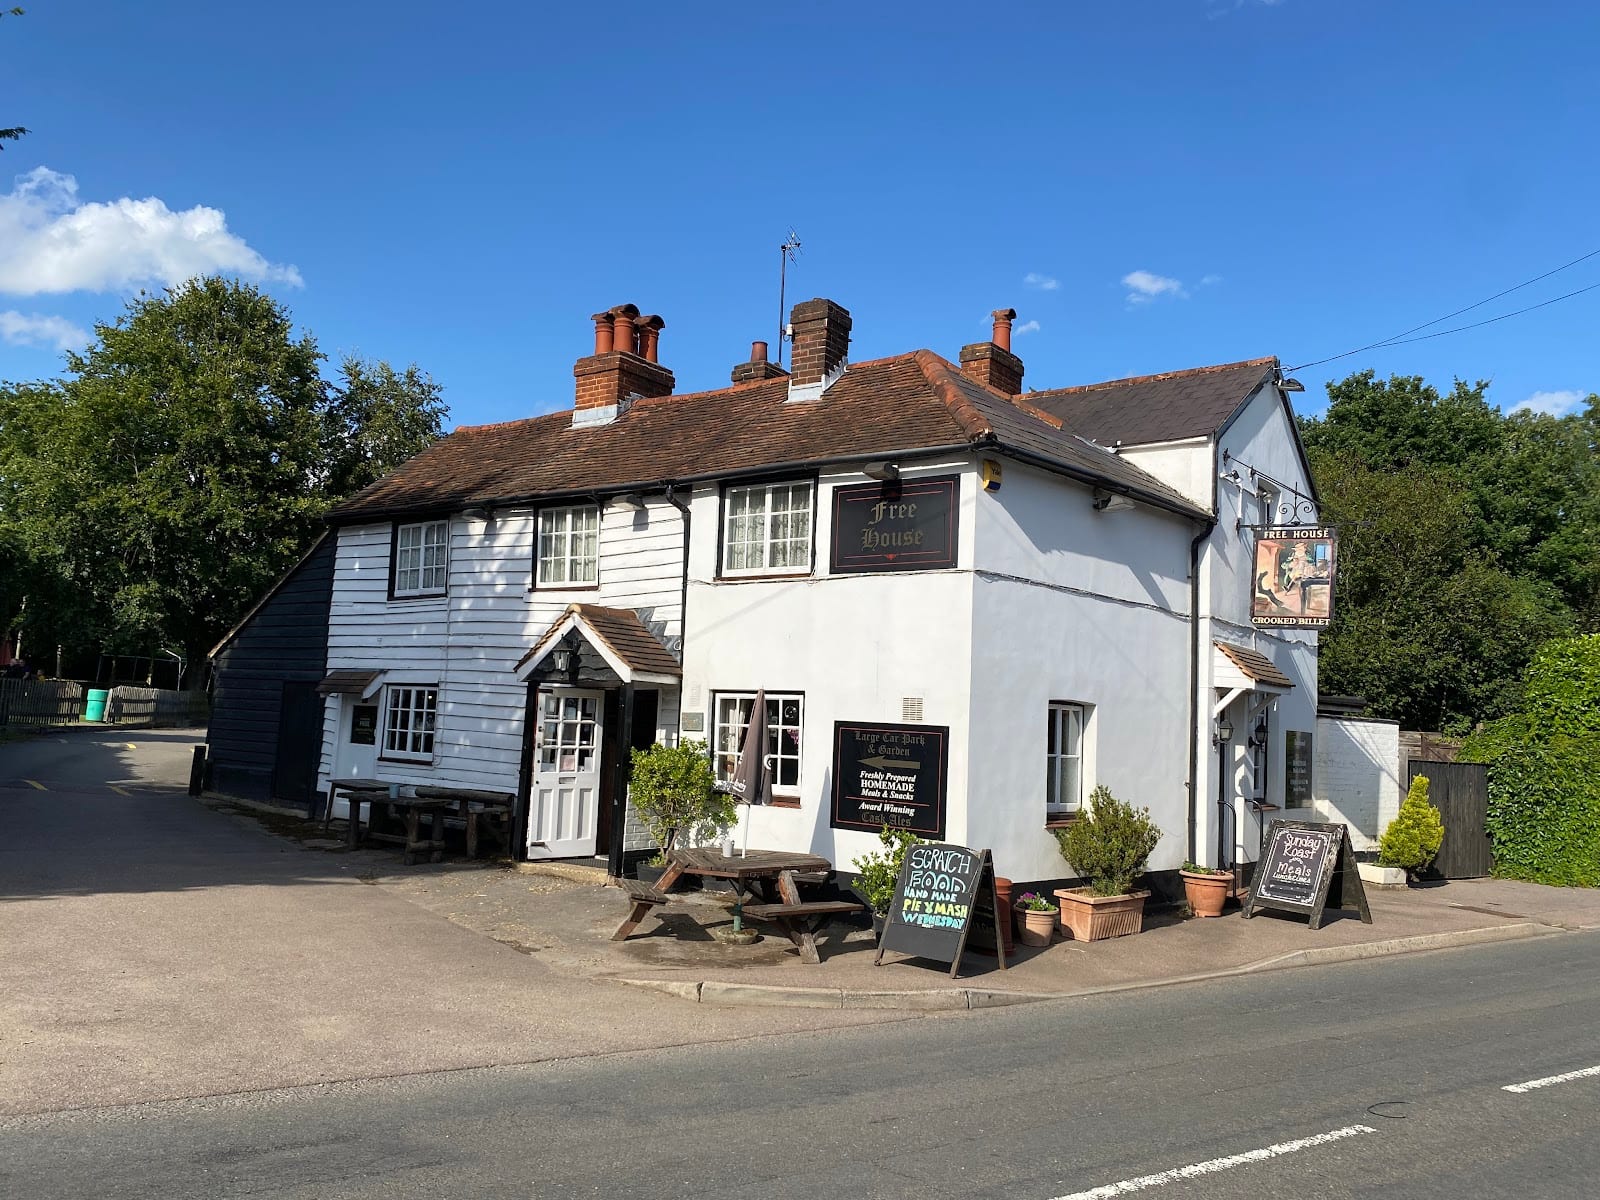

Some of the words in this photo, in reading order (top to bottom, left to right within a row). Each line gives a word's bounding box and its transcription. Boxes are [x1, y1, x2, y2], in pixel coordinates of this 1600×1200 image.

[868, 502, 917, 525] Free
[861, 527, 923, 551] House
[1264, 531, 1287, 539] FREE
[1293, 529, 1329, 538] HOUSE
[1252, 617, 1296, 625] CROOKED
[1298, 617, 1330, 626] BILLET
[855, 732, 879, 743] Large
[882, 733, 900, 743] Car
[902, 734, 925, 746] Park
[867, 744, 876, 754] &
[878, 745, 910, 756] Garden
[860, 771, 885, 780] Freshly
[886, 773, 916, 782] Prepared
[861, 780, 915, 791] HOMEMADE
[861, 788, 881, 797] Meals
[881, 790, 888, 798] &
[889, 791, 914, 801] Snacks
[858, 802, 882, 811] Award
[883, 803, 915, 817] Winning
[861, 812, 886, 823] Cask
[889, 814, 911, 826] Ales
[1284, 833, 1321, 850] Sunday
[1283, 845, 1316, 859] Roast
[910, 849, 971, 874] SCRATCH
[1277, 862, 1311, 877] Meals
[909, 870, 965, 893] FOOD
[904, 886, 928, 899] HAND
[931, 891, 957, 902] MADE
[902, 898, 921, 911] PIE
[934, 903, 968, 918] MASH
[902, 911, 965, 929] WEDNESDAY
